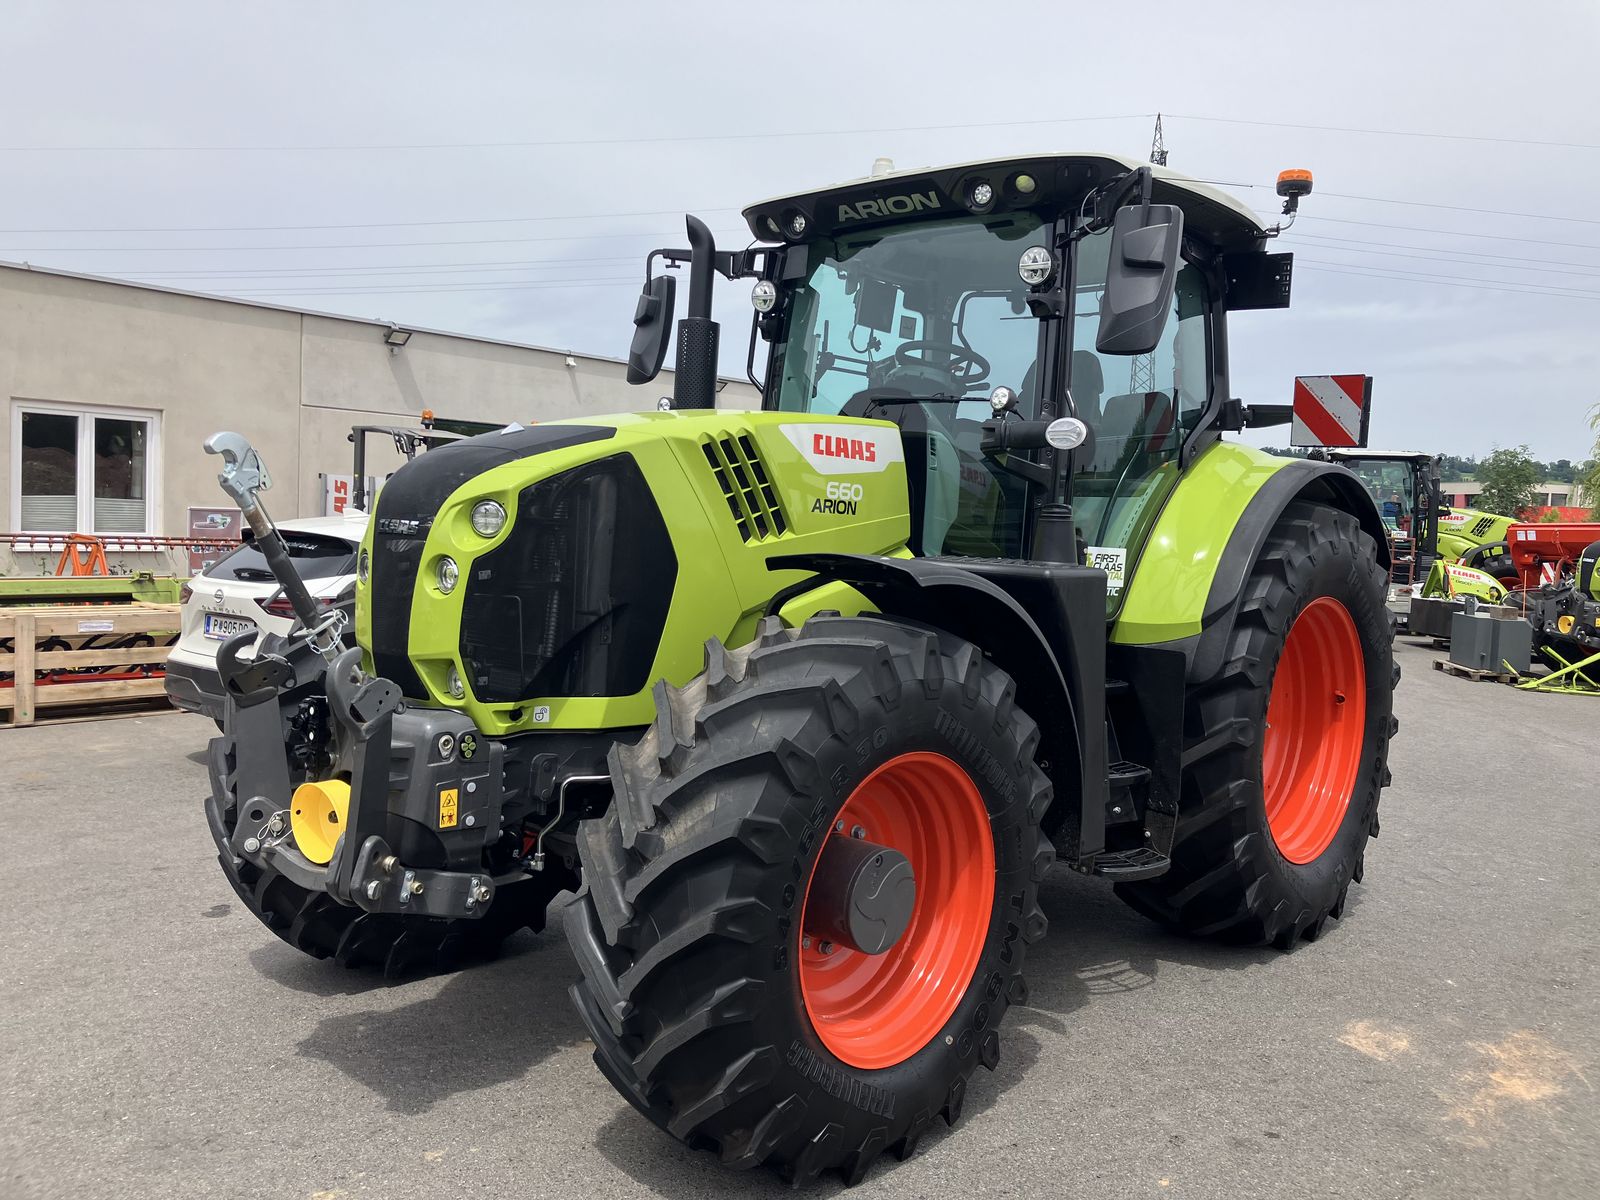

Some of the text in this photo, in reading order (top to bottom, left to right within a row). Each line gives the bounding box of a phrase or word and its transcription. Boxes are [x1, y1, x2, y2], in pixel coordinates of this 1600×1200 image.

[838, 191, 941, 222] ARION
[813, 433, 876, 462] CLAAS
[826, 481, 864, 501] 660
[811, 498, 857, 515] ARION
[1094, 553, 1121, 563] FIRST
[1107, 571, 1123, 580] TAL
[1453, 569, 1481, 579] CLAAS
